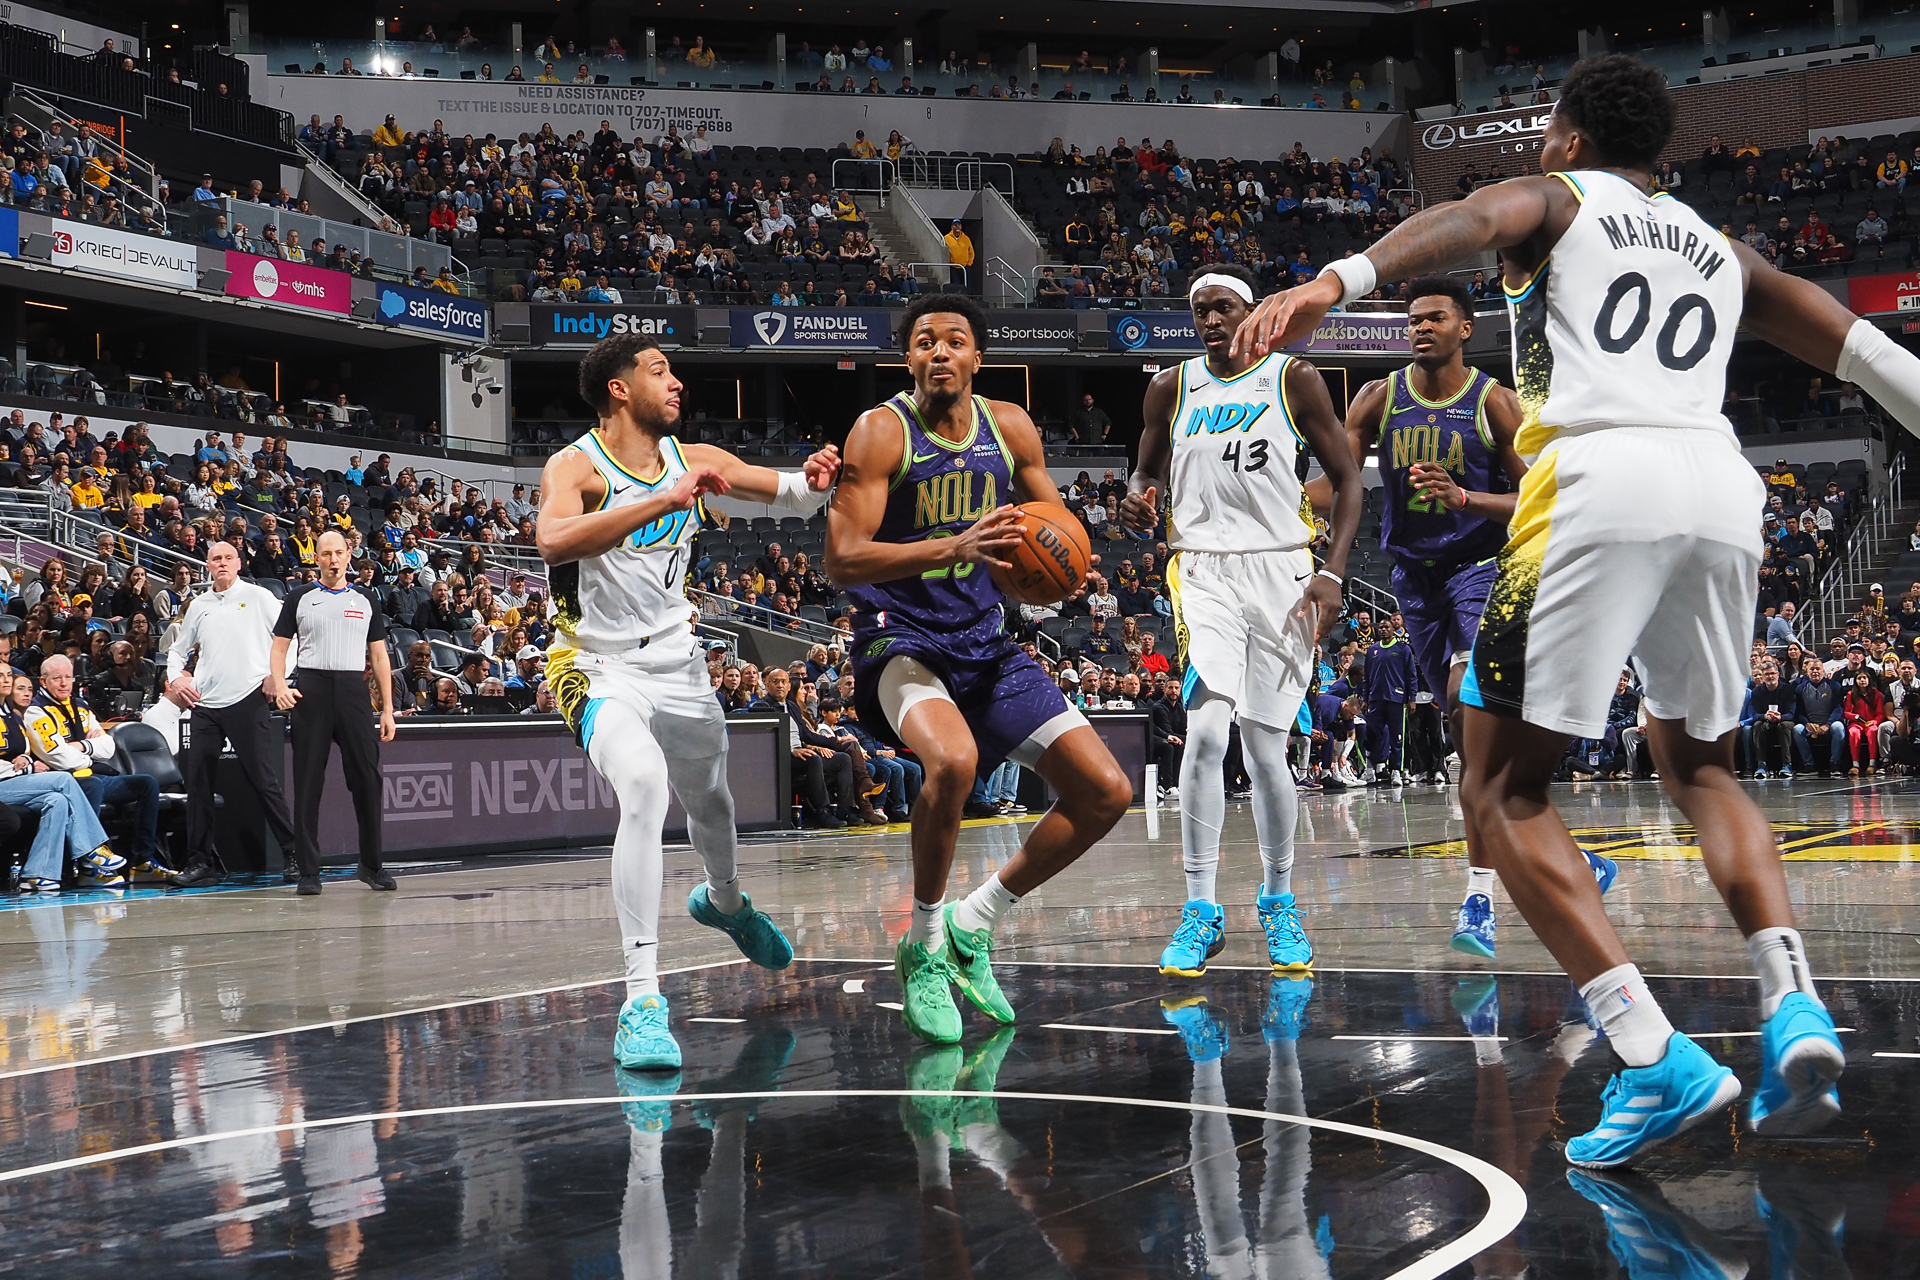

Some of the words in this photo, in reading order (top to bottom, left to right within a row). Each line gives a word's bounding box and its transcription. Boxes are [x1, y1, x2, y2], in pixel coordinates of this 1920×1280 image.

[1, 4, 11, 19] 107
[279, 85, 284, 98] 7
[519, 87, 552, 98] NEED
[556, 88, 645, 101] ASSISTANCE?
[438, 100, 470, 112] TEXT
[472, 101, 497, 113] THE
[501, 102, 538, 113] ISSUE
[541, 103, 551, 113] &
[553, 103, 614, 116] LOCATION
[616, 105, 632, 116] TO
[635, 106, 723, 119] 707-TIMEOUT.
[864, 105, 868, 117] 7
[926, 107, 931, 119] 8
[630, 117, 665, 132] (707)
[1366, 121, 1370, 133] 8
[1459, 114, 1552, 139] LEXUS
[1501, 142, 1539, 153] LOF
[76, 240, 122, 260] KRIEG
[128, 250, 196, 273] DEVAULT
[1598, 213, 1725, 281] MATHURIN
[304, 282, 325, 298] mhs
[409, 298, 482, 328] salesforce
[793, 317, 868, 330] FANDUEL
[1593, 271, 1717, 371] 00
[554, 312, 674, 338] IndyStar.
[794, 332, 826, 340] SPORTS
[828, 332, 868, 340] NETWORK
[1001, 326, 1075, 340] Sportsbook
[1153, 326, 1195, 338] Sports
[1185, 401, 1271, 439] INDY
[1222, 438, 1269, 473] 43
[1392, 424, 1465, 476] NOLA
[914, 470, 997, 529] NOLA
[1035, 524, 1079, 587] Wilson
[664, 549, 679, 590] 0
[384, 775, 453, 809] NEXEN
[470, 758, 614, 817] NEXEN
